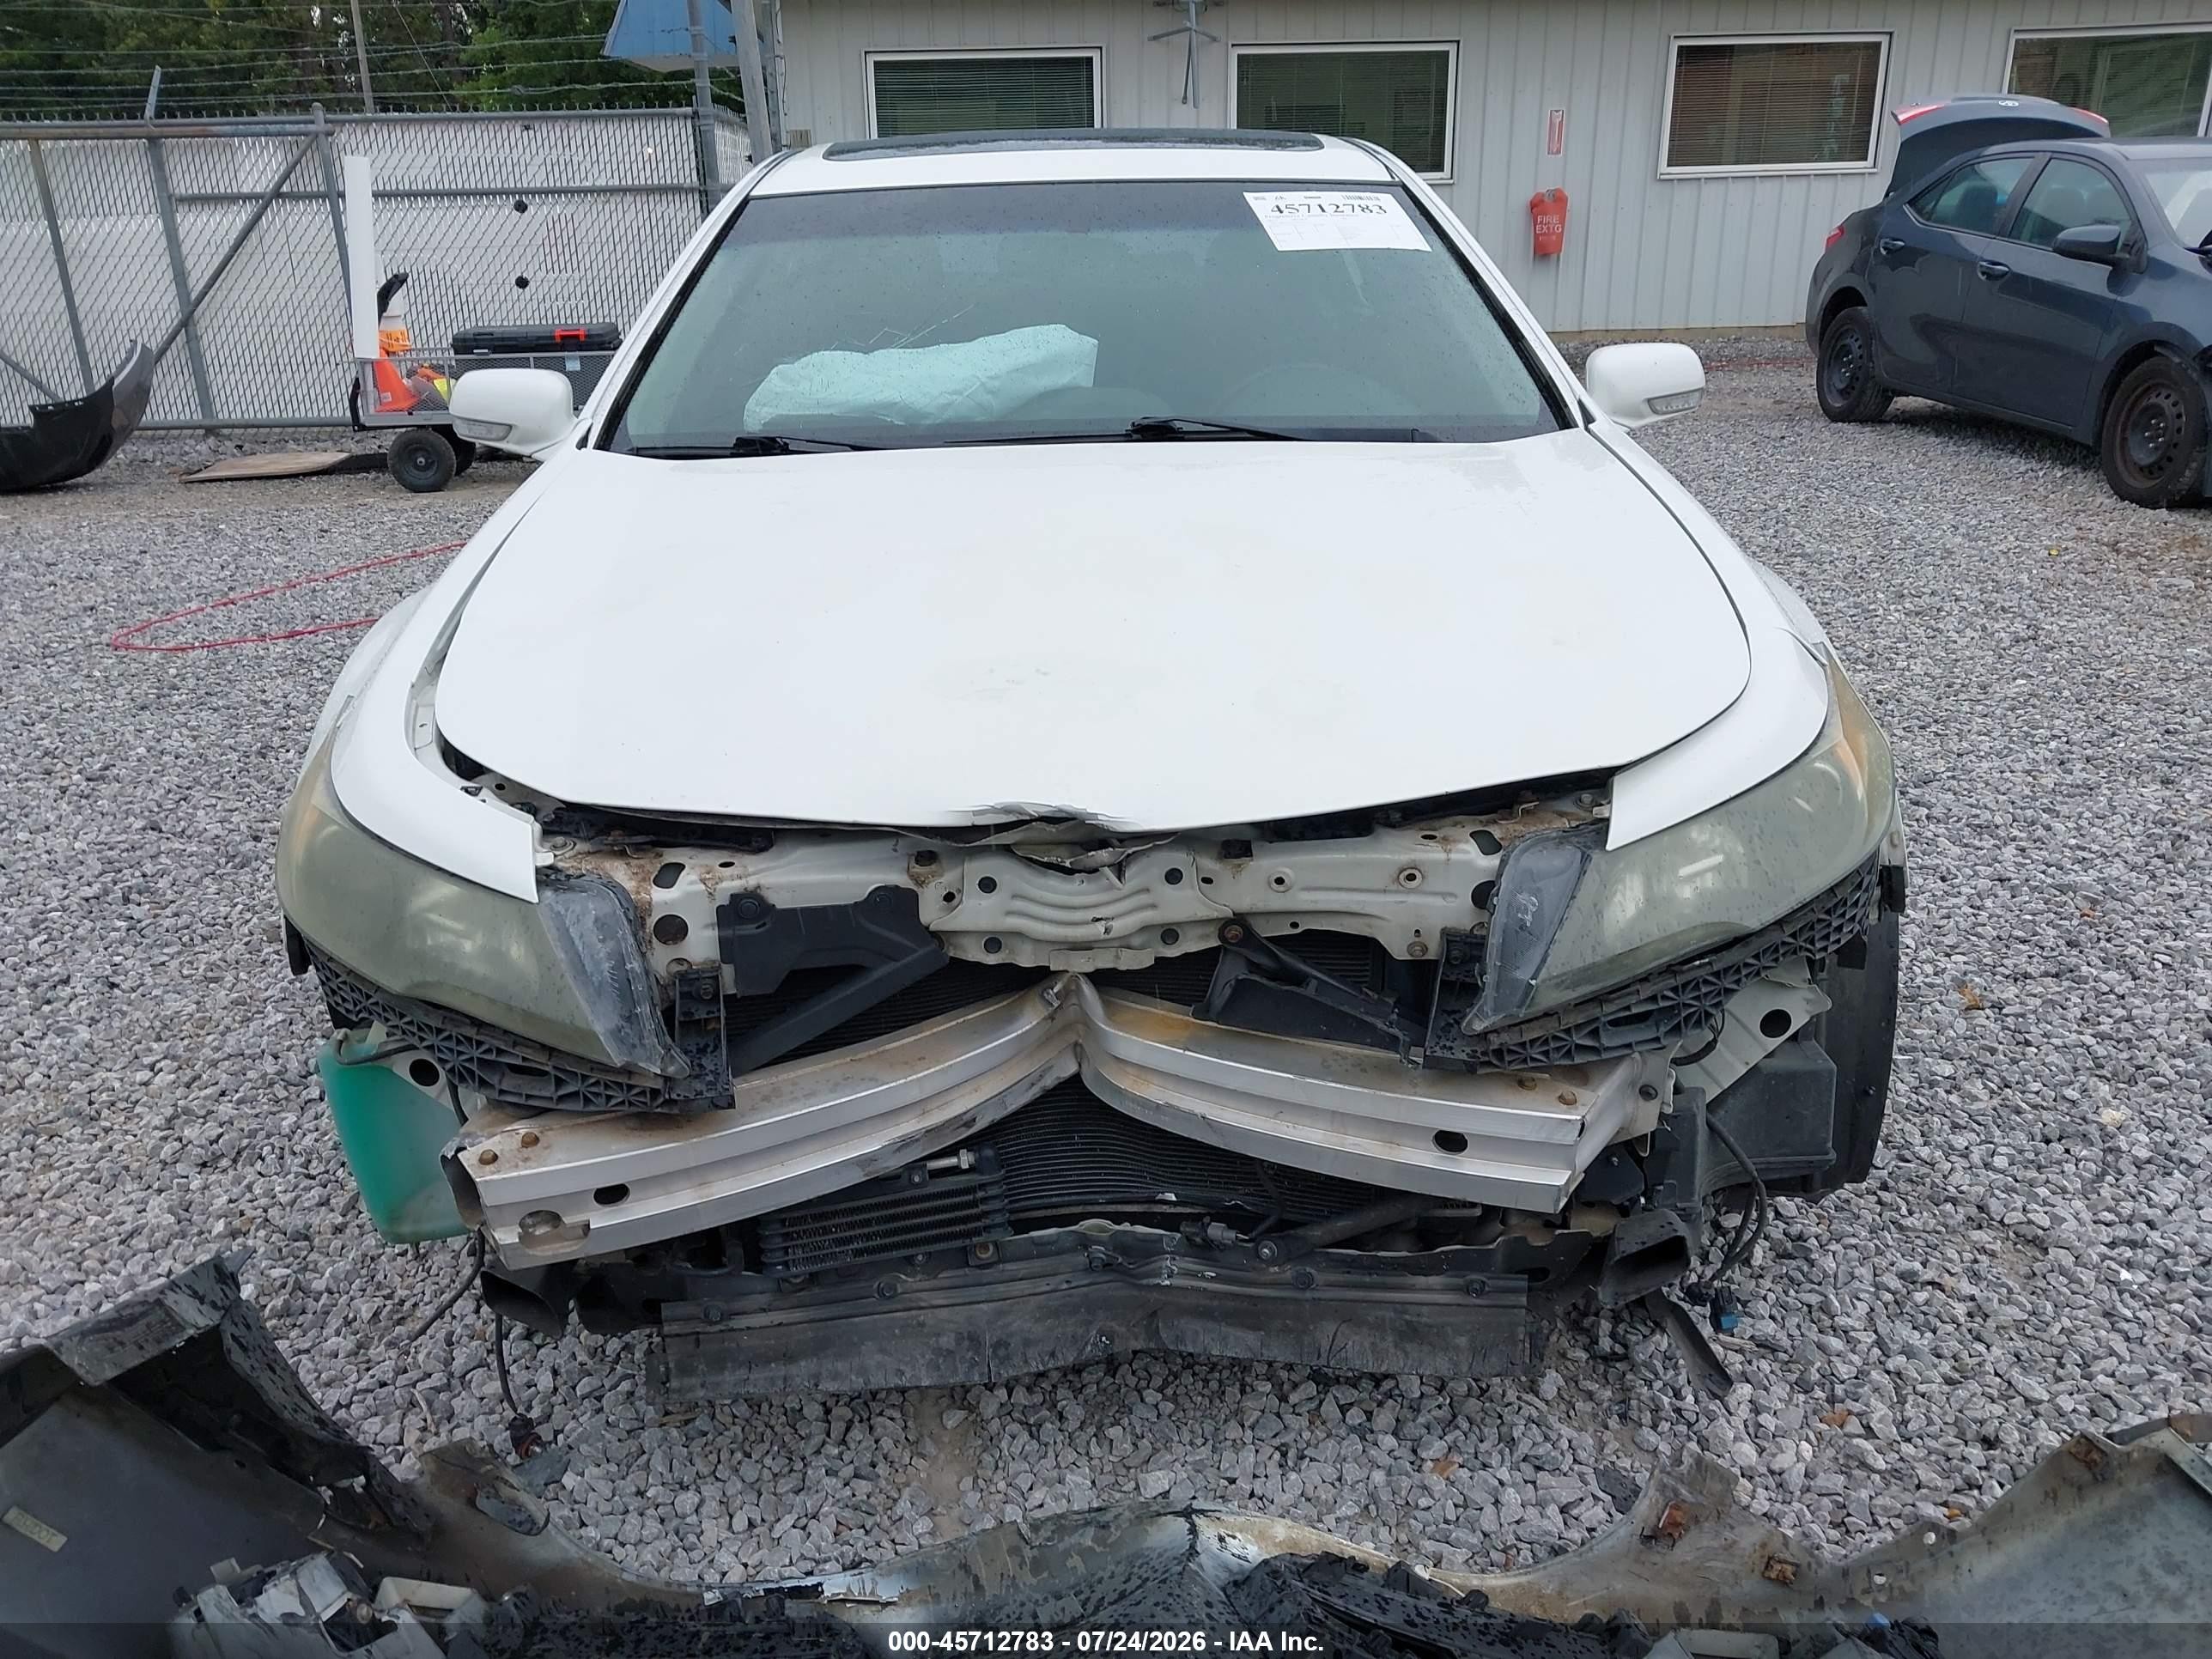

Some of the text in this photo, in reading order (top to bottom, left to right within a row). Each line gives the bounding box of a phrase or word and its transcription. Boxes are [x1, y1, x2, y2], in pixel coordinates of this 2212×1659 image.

[1270, 203, 1388, 215] 45712783
[1537, 214, 1560, 224] FIRE
[1535, 223, 1562, 234] EXTG
